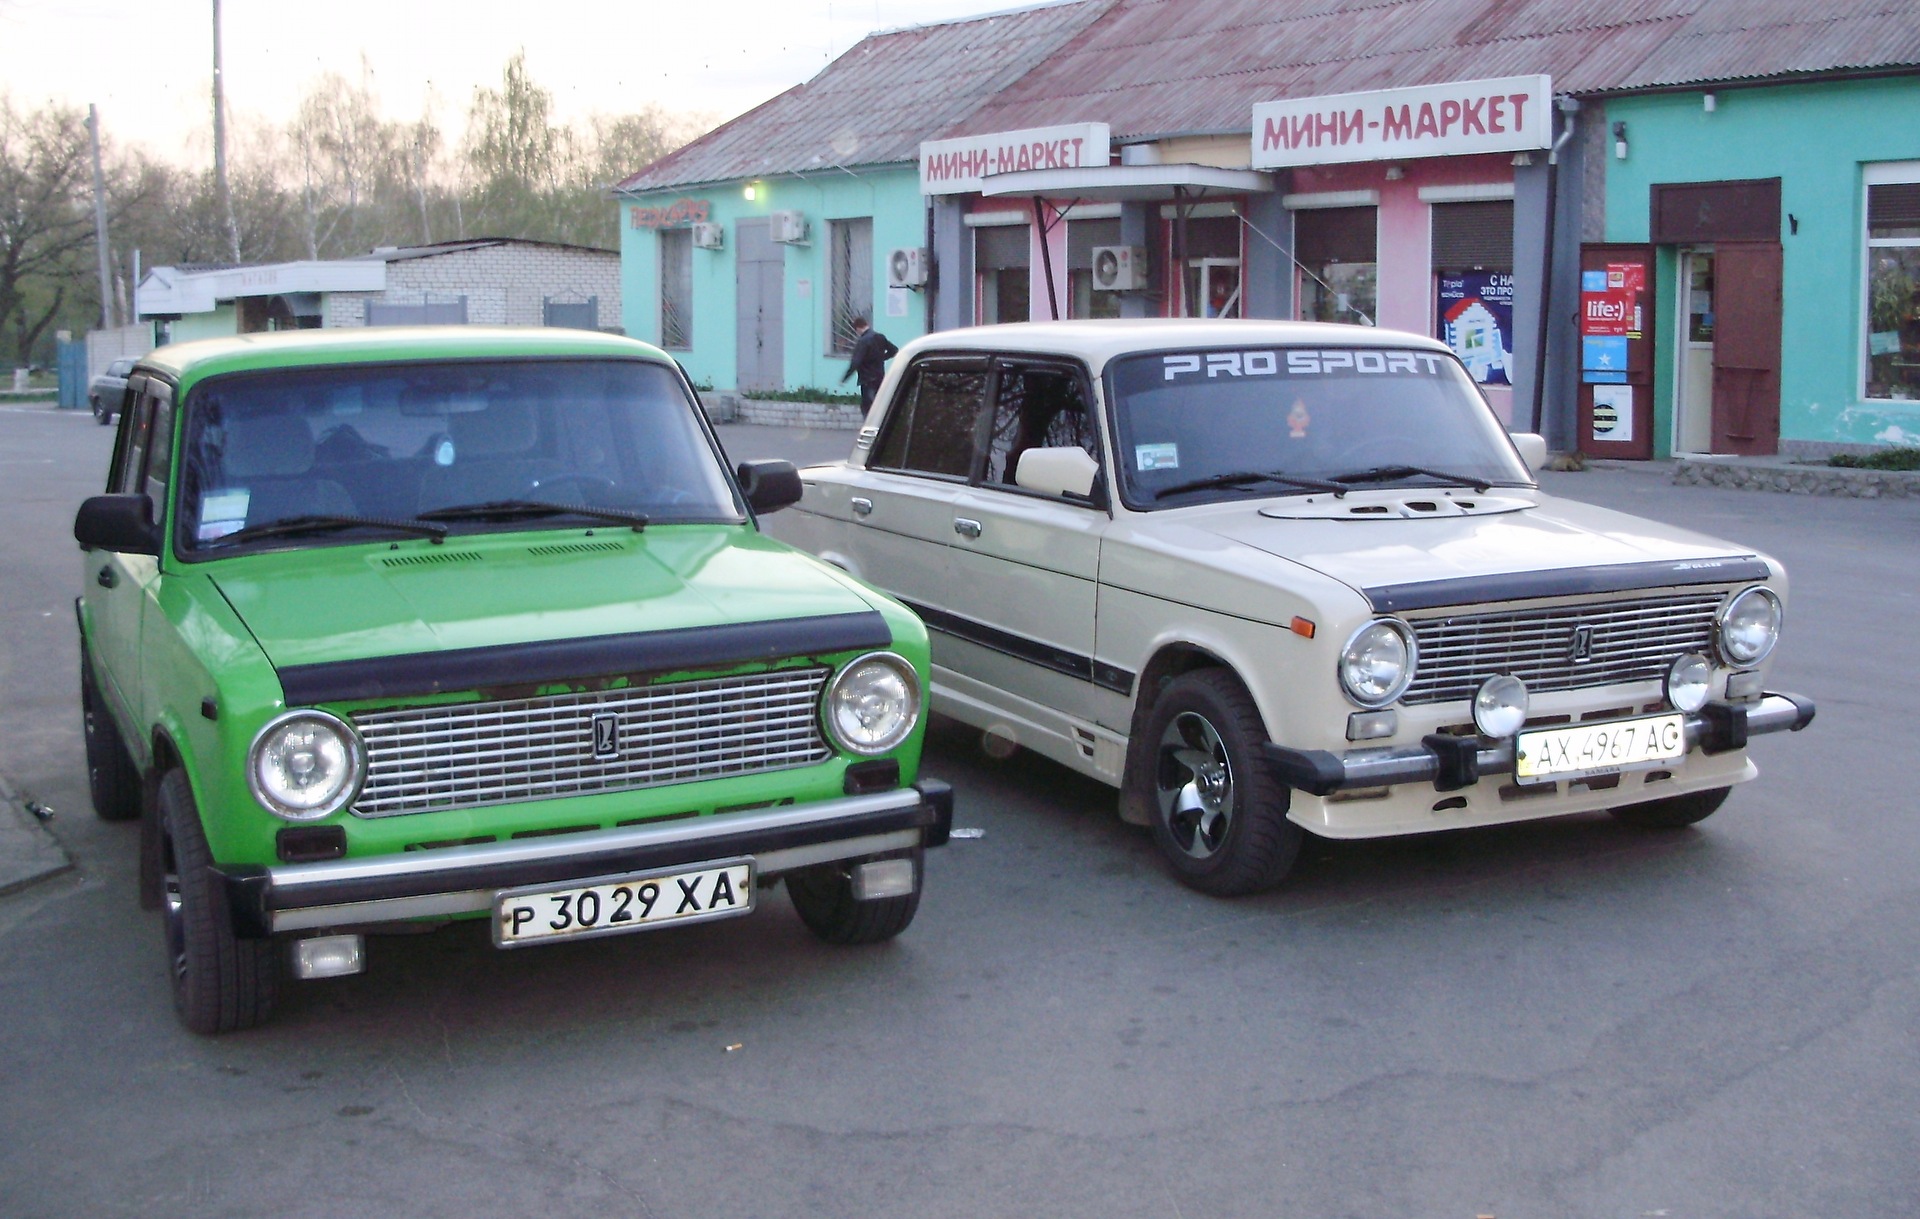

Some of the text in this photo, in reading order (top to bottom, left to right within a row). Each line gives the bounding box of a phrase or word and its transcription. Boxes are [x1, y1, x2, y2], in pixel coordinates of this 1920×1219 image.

[1262, 93, 1529, 151] МИНИ-МАРКЕТ
[927, 137, 1083, 181] МИНИ-МАРКЕТ
[1480, 287, 1496, 295] ЭТО
[1587, 300, 1624, 321] life:)
[1163, 351, 1441, 381] PRO SPORT
[1537, 737, 1571, 768] AX
[1581, 727, 1635, 762] 4967
[549, 882, 660, 931] 3029
